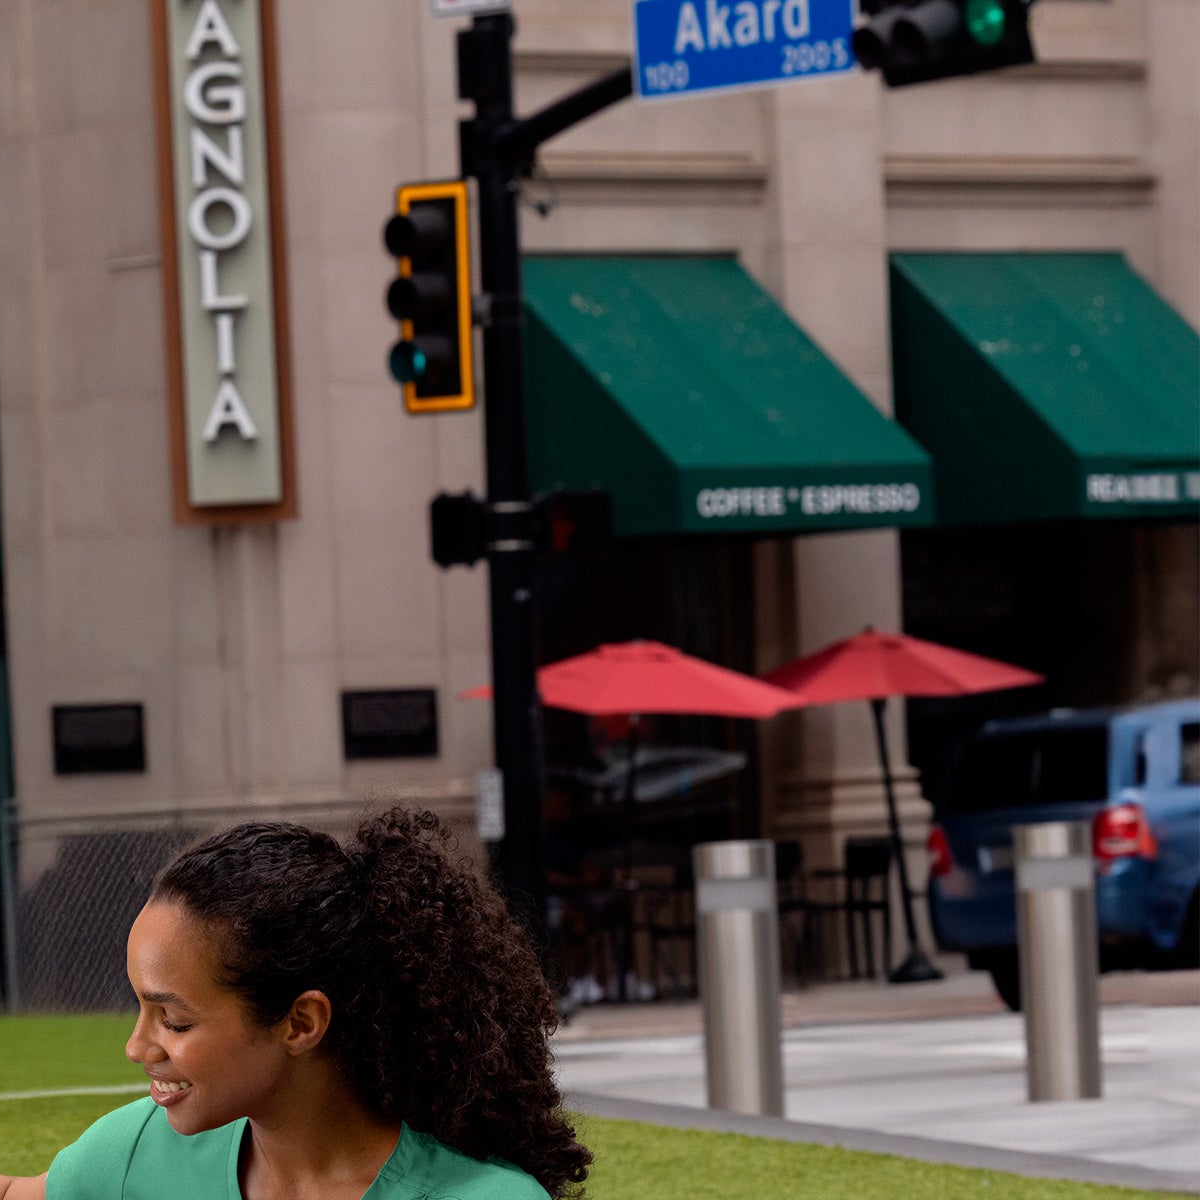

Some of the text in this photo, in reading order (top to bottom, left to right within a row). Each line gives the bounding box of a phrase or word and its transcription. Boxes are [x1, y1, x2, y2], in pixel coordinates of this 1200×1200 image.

[674, 0, 811, 55] Akard
[645, 60, 690, 91] 100
[696, 482, 921, 518] COFFEE ESPRESSO
